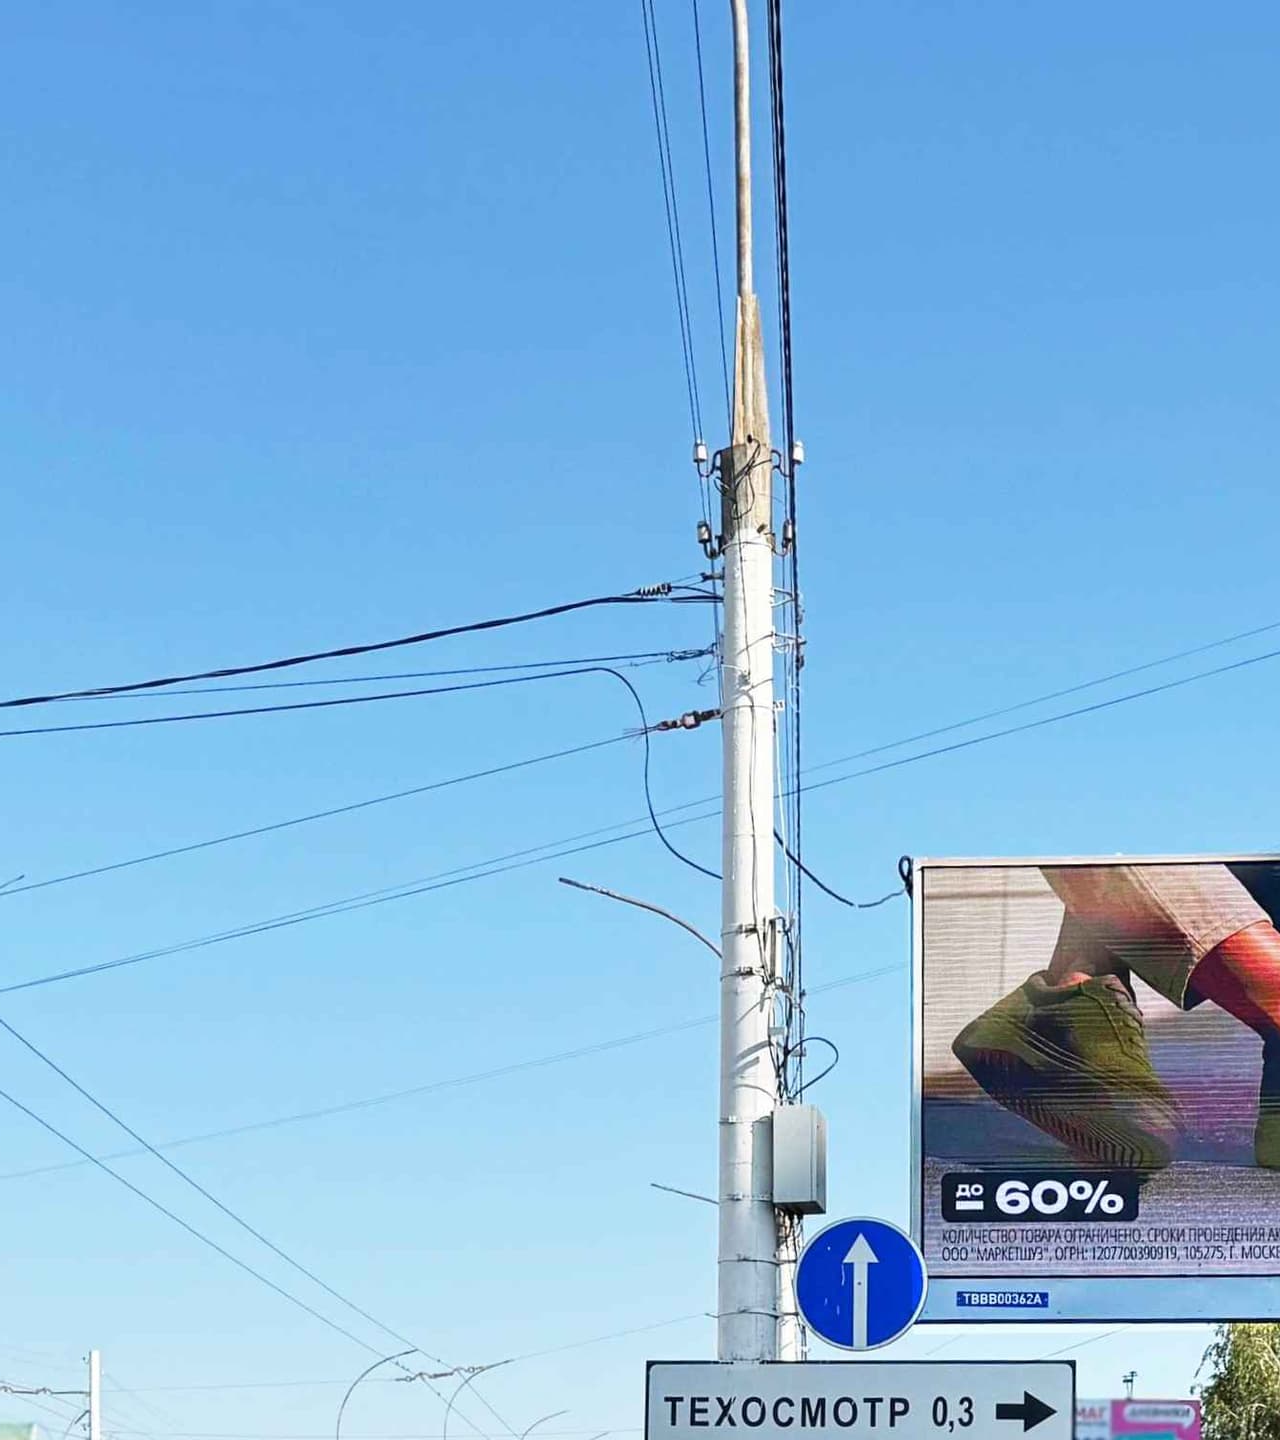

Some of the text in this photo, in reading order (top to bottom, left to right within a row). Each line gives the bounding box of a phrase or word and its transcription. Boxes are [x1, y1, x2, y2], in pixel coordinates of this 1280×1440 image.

[942, 1229, 1017, 1244] КОЛИЧЕСТВО
[1020, 1229, 1061, 1244] ТОВАРА
[1147, 1227, 1185, 1243] СРОКИ
[1188, 1226, 1265, 1244] ПРОВЕДЕНИЯ
[942, 1246, 969, 1261] ООО
[663, 1395, 975, 1434] ТЕХОСМОТР 0,3
